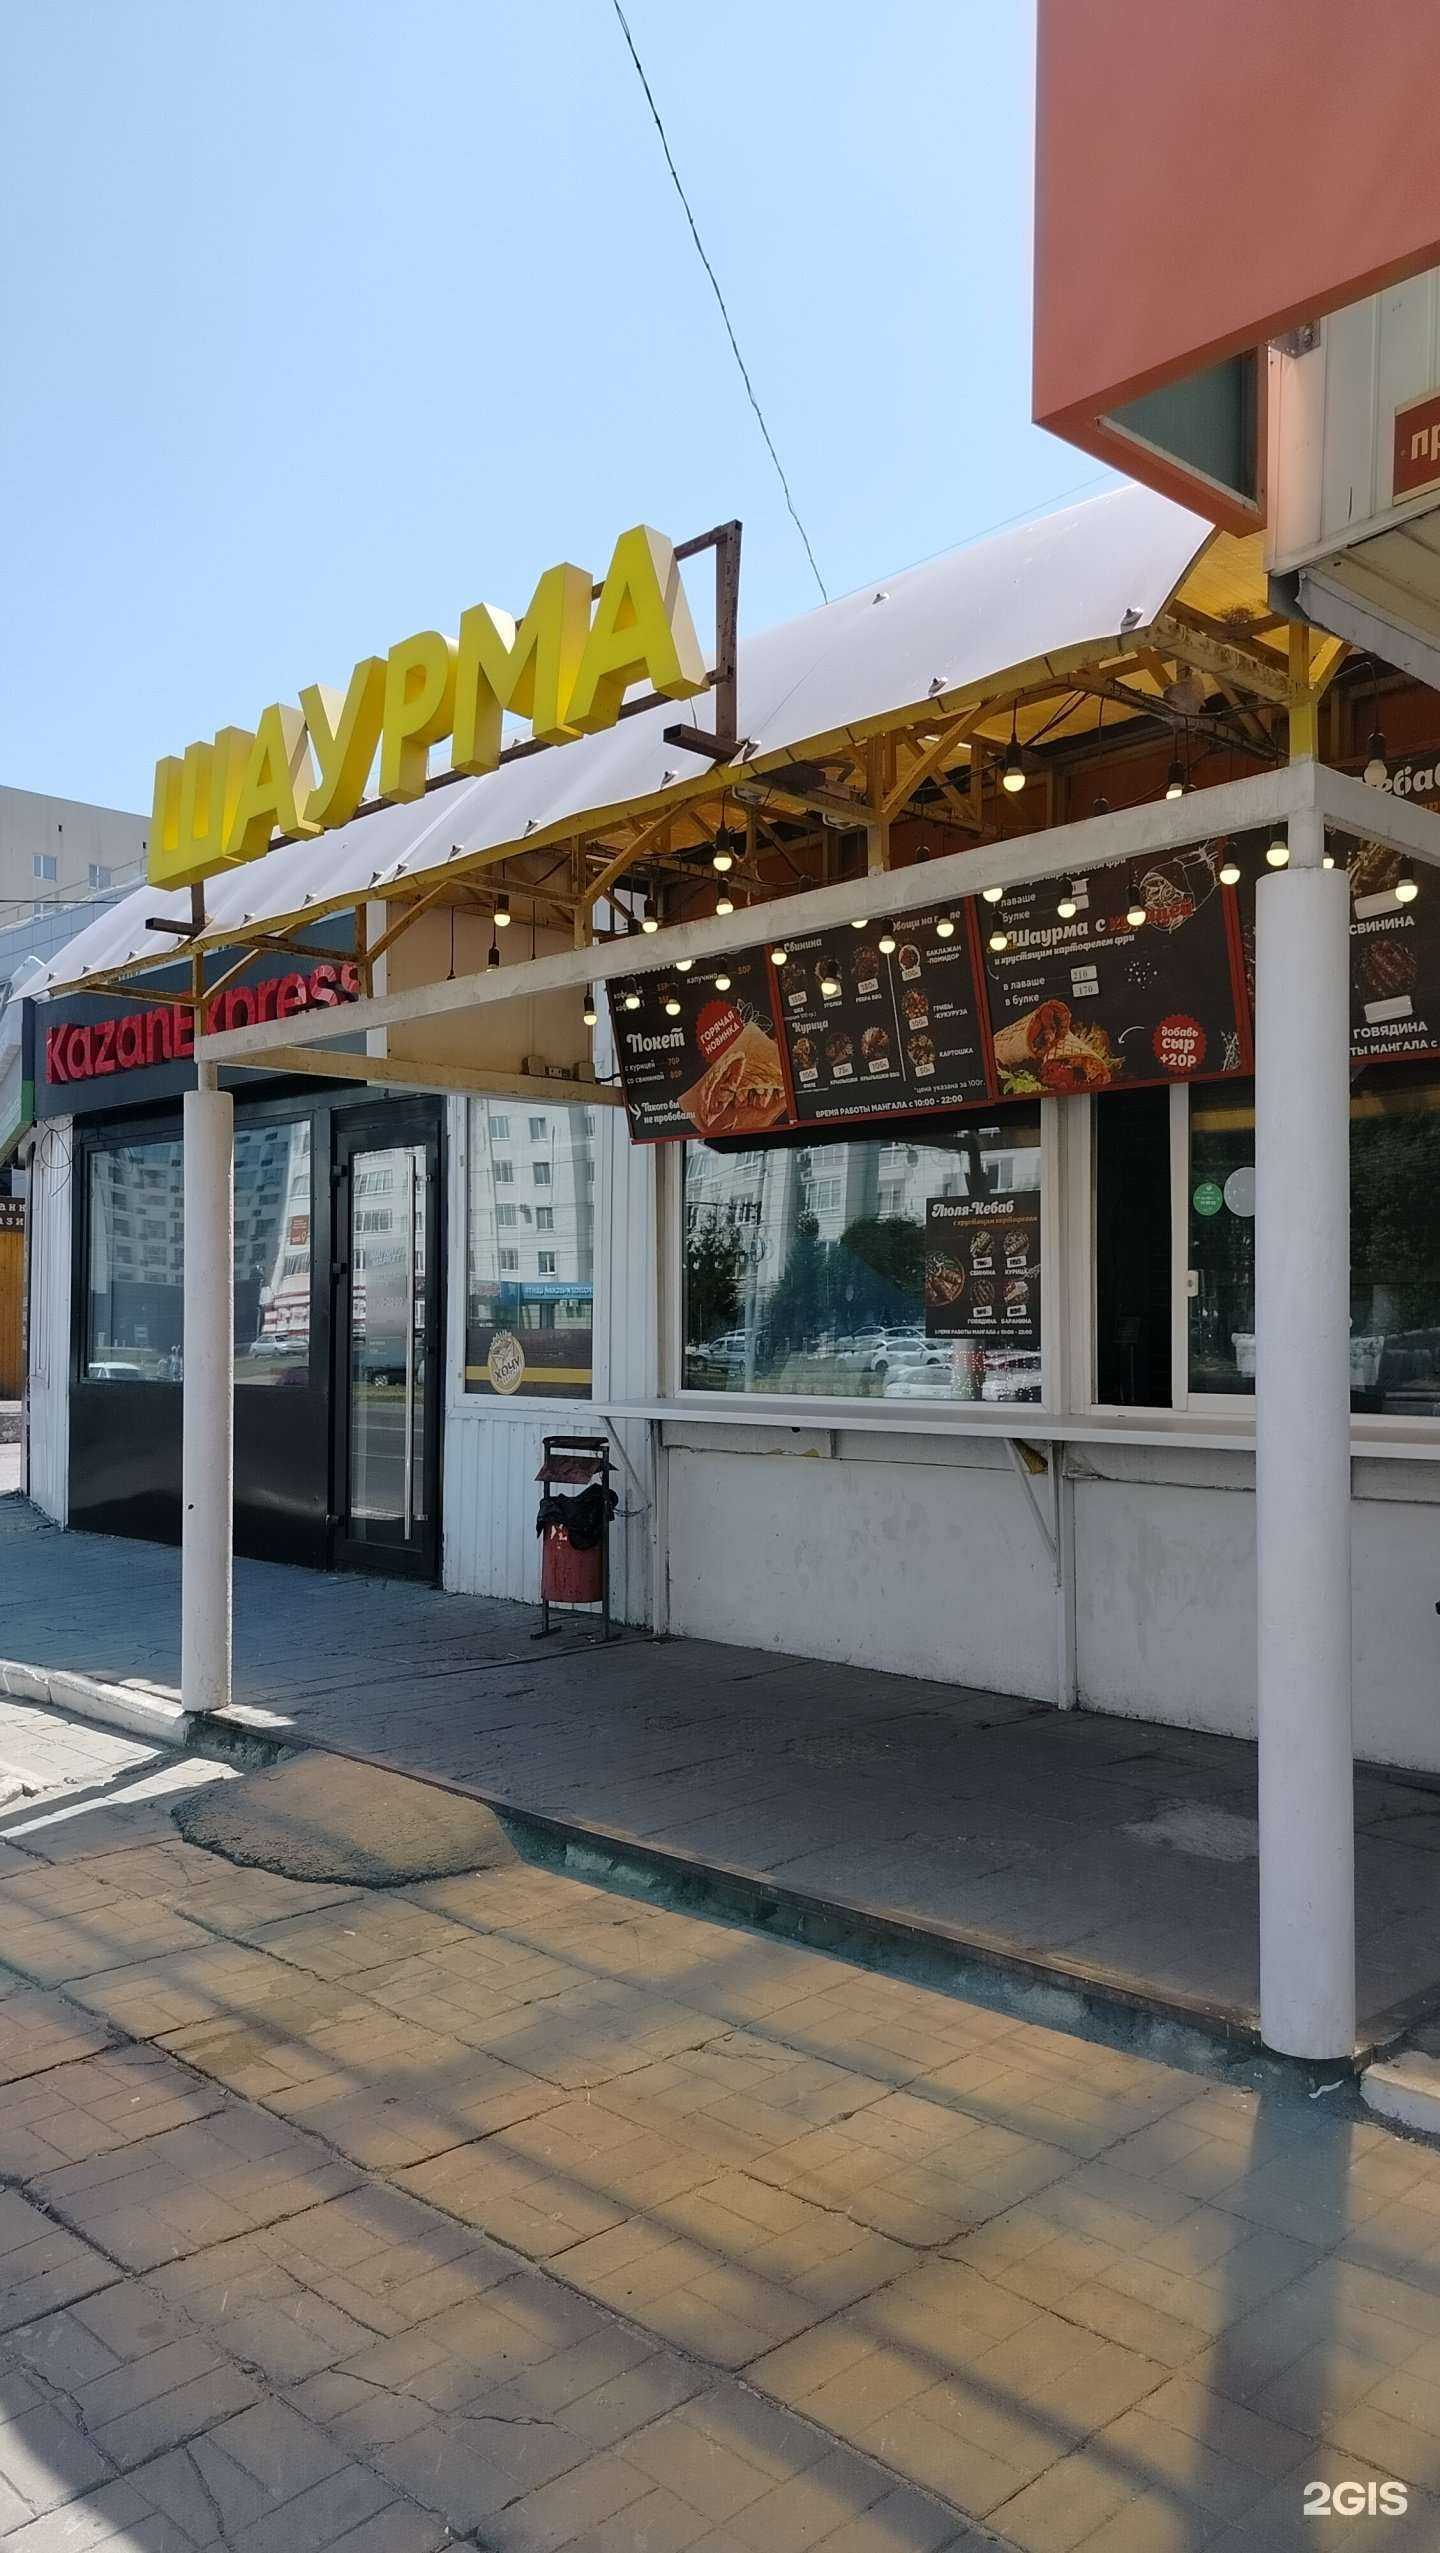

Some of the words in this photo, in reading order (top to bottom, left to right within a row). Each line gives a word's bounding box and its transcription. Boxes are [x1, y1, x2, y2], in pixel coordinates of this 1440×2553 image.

[147, 524, 710, 892] ШАУРМА
[1001, 893, 1037, 908] лаваше
[1006, 921, 1089, 948] Шаурма
[1095, 918, 1107, 931] с
[1349, 914, 1416, 937] СВИНИНА
[784, 937, 823, 953] Свинина
[1114, 933, 1136, 946] фри
[926, 943, 962, 957] БАКЛАЖАН
[1003, 982, 1009, 991] в
[1010, 976, 1046, 990] лаваше
[1005, 998, 1011, 1007] в
[1012, 992, 1040, 1006] булке
[699, 1010, 736, 1045] ГОРЯЧАЯ
[791, 1019, 829, 1034] Курица
[1161, 1026, 1199, 1037] добавь
[1352, 1020, 1429, 1040] ГОВЯДИНА
[626, 1025, 686, 1053] Покет
[704, 1022, 741, 1055] НОВИНКА
[1161, 1038, 1196, 1054] сыр
[1369, 1038, 1429, 1056] МАНГАЛА
[629, 1059, 656, 1073] курицей
[815, 1105, 840, 1118] ВРЕМЯ
[839, 1102, 871, 1117] РАБОТЫ
[872, 1100, 908, 1114] МАНГАЛА
[915, 1097, 935, 1109] 10:00
[941, 1094, 964, 1106] 22:00
[931, 1200, 1015, 1218] Люля-Кебаб
[495, 1356, 520, 1381] ХОЧУ
